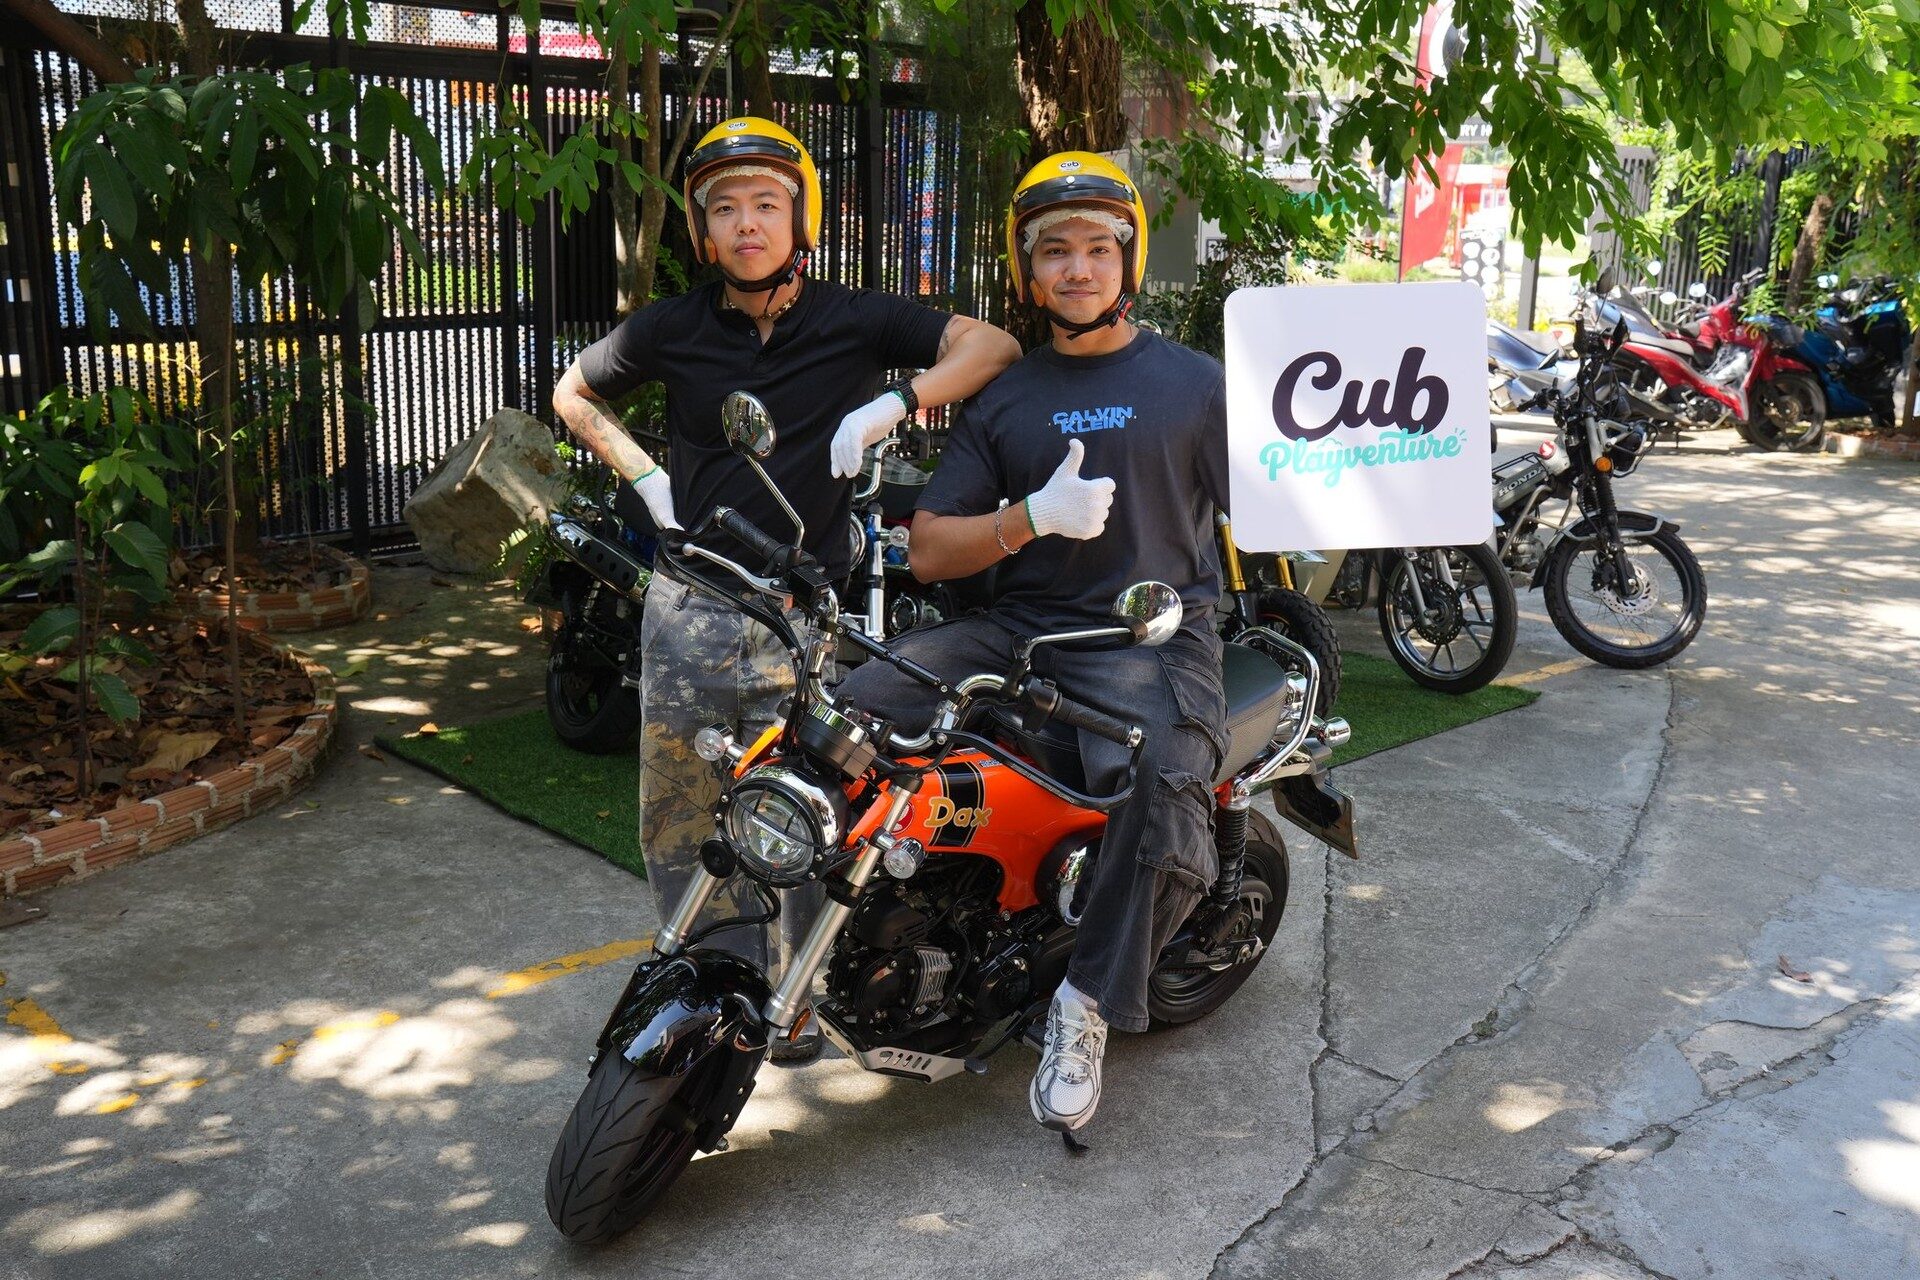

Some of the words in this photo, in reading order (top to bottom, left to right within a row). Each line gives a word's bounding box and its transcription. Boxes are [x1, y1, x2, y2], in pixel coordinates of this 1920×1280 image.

[1272, 346, 1449, 442] Cub
[1052, 406, 1133, 426] CALVIN
[1060, 415, 1126, 434] KLEIN
[1259, 424, 1462, 489] Playventure
[923, 796, 993, 828] Dax
